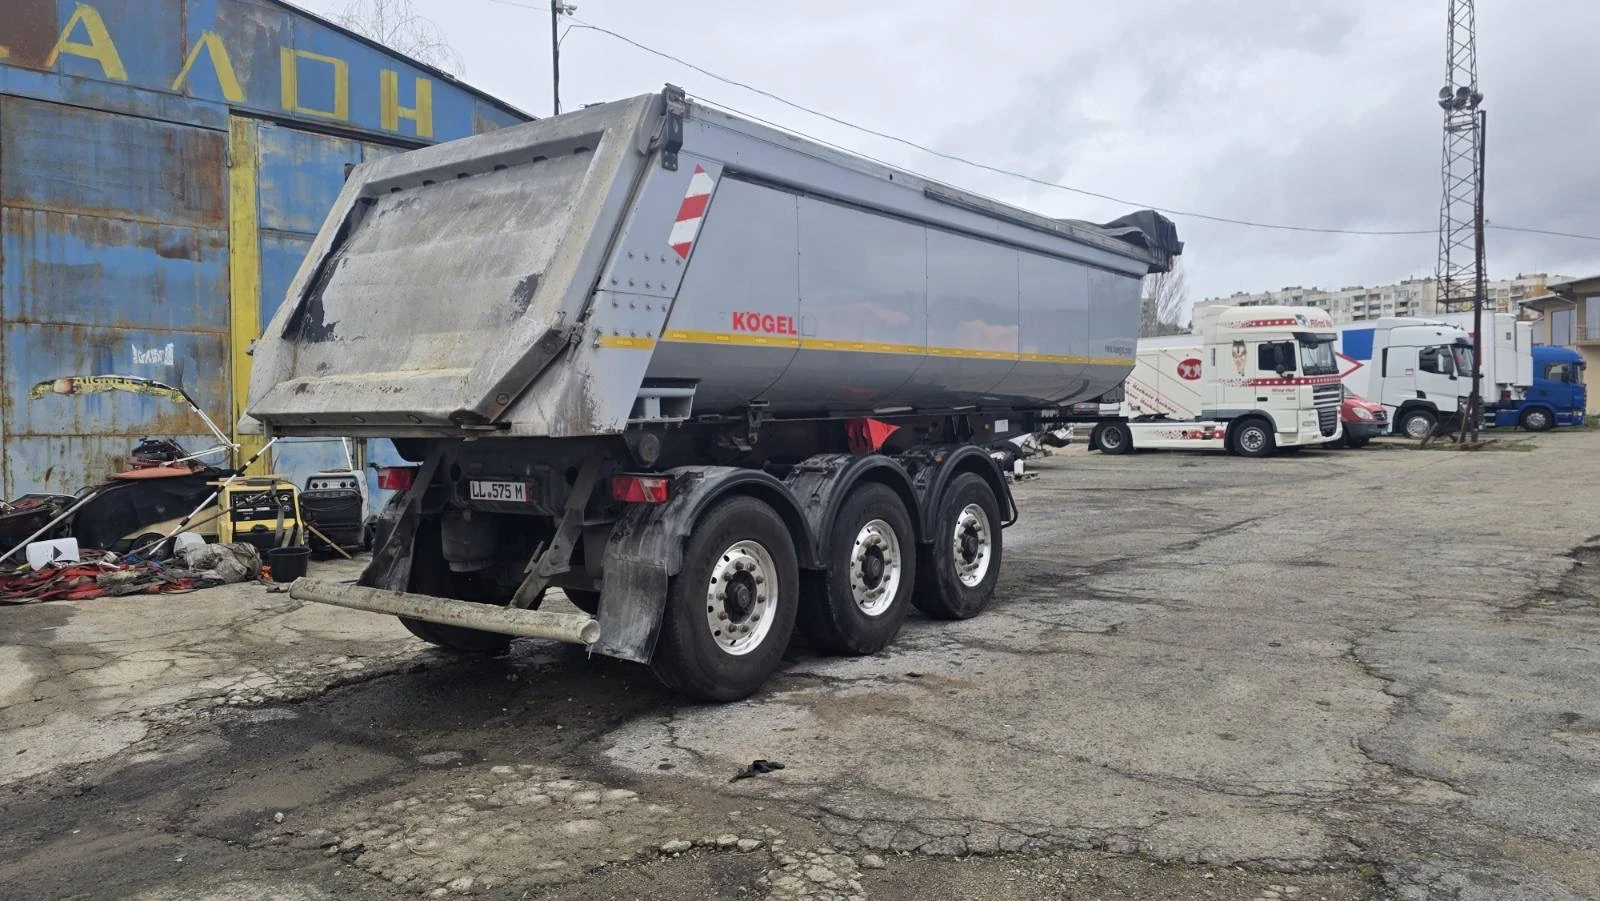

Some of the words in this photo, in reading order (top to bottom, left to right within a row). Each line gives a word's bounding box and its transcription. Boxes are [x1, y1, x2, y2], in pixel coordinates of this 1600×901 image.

[0, 2, 433, 138] АЛОН
[733, 311, 797, 335] KÖGEL
[515, 484, 523, 499] M
